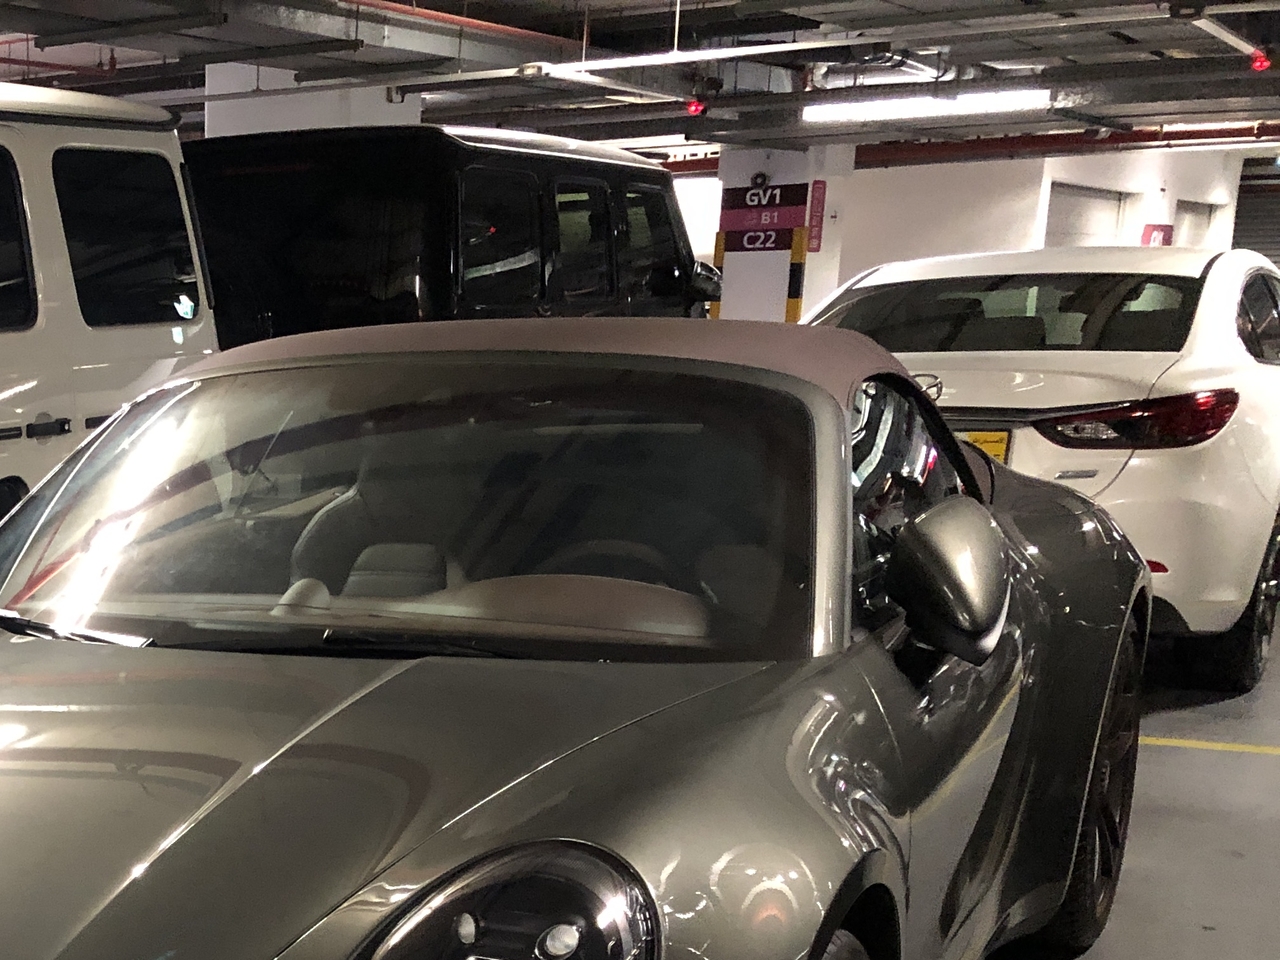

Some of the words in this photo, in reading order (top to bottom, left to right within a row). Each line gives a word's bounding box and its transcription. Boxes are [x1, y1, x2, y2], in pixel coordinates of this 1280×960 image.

[745, 188, 780, 205] GV1
[761, 212, 778, 224] B1
[743, 231, 776, 248] C22
